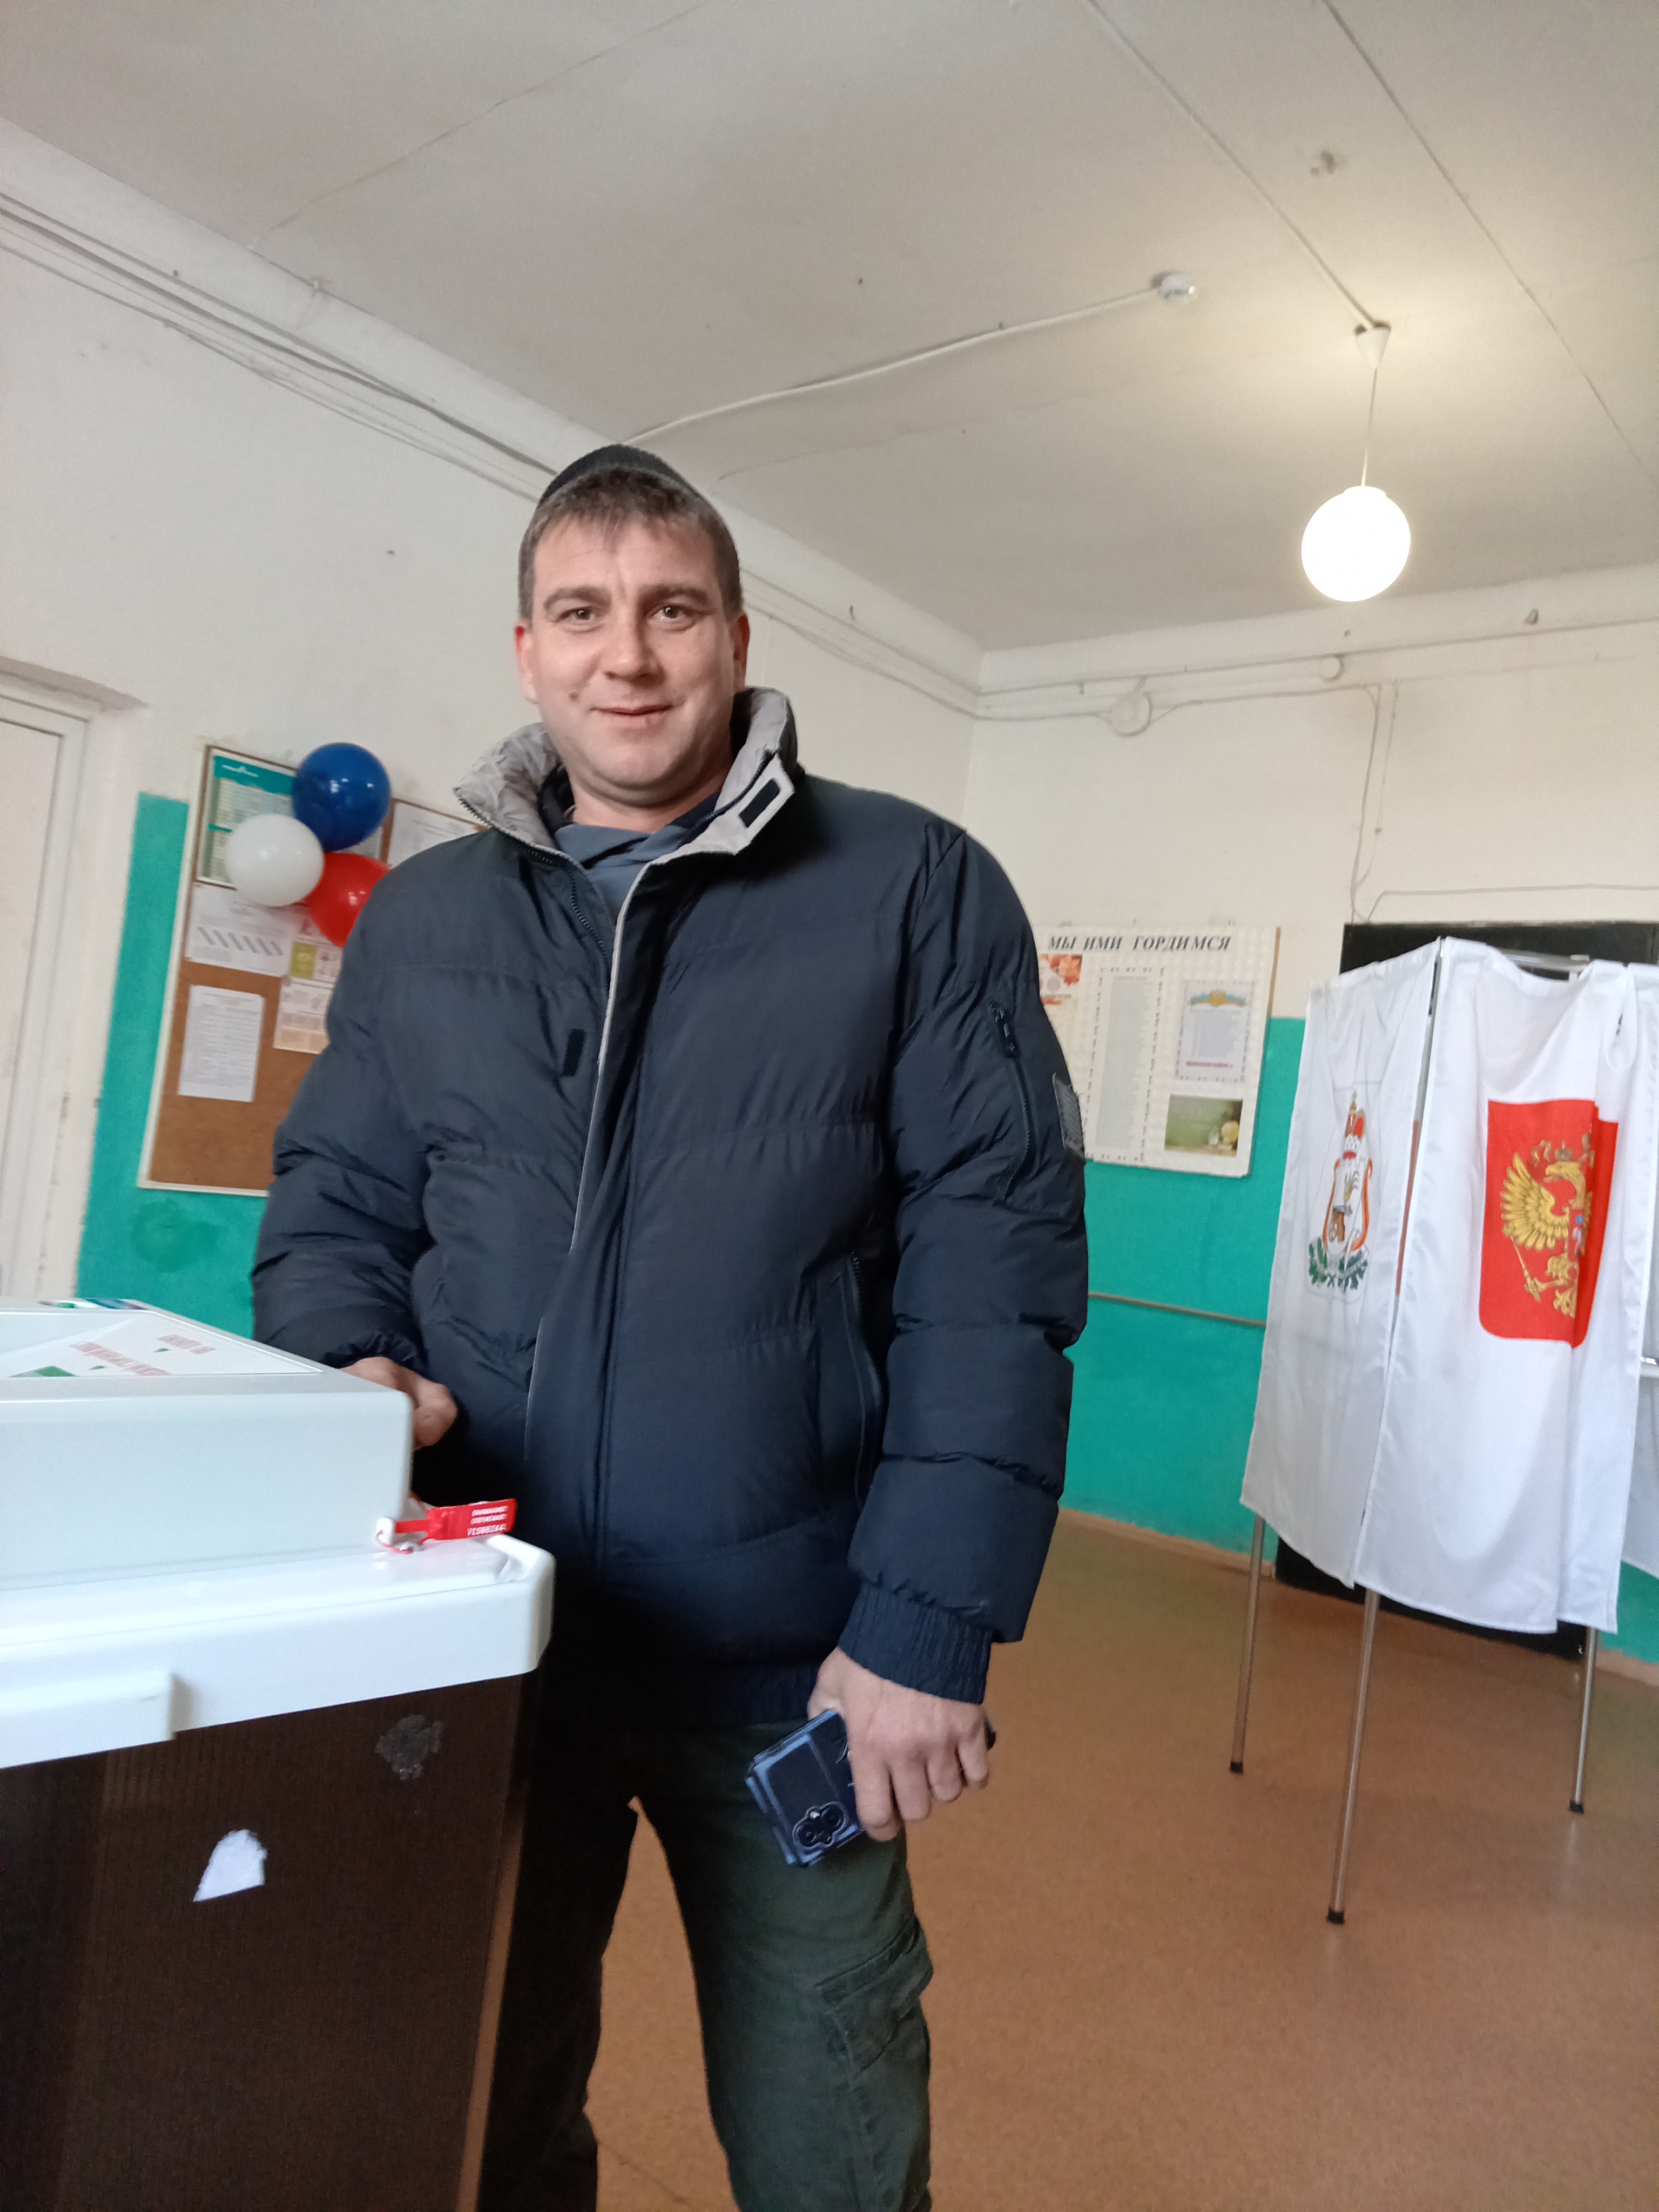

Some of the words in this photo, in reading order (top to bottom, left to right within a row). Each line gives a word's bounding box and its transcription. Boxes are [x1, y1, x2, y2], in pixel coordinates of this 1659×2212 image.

[1048, 935, 1076, 950] МЫ
[1083, 935, 1123, 951] ИМИ
[1132, 935, 1231, 952] ГОРДИМСЯ
